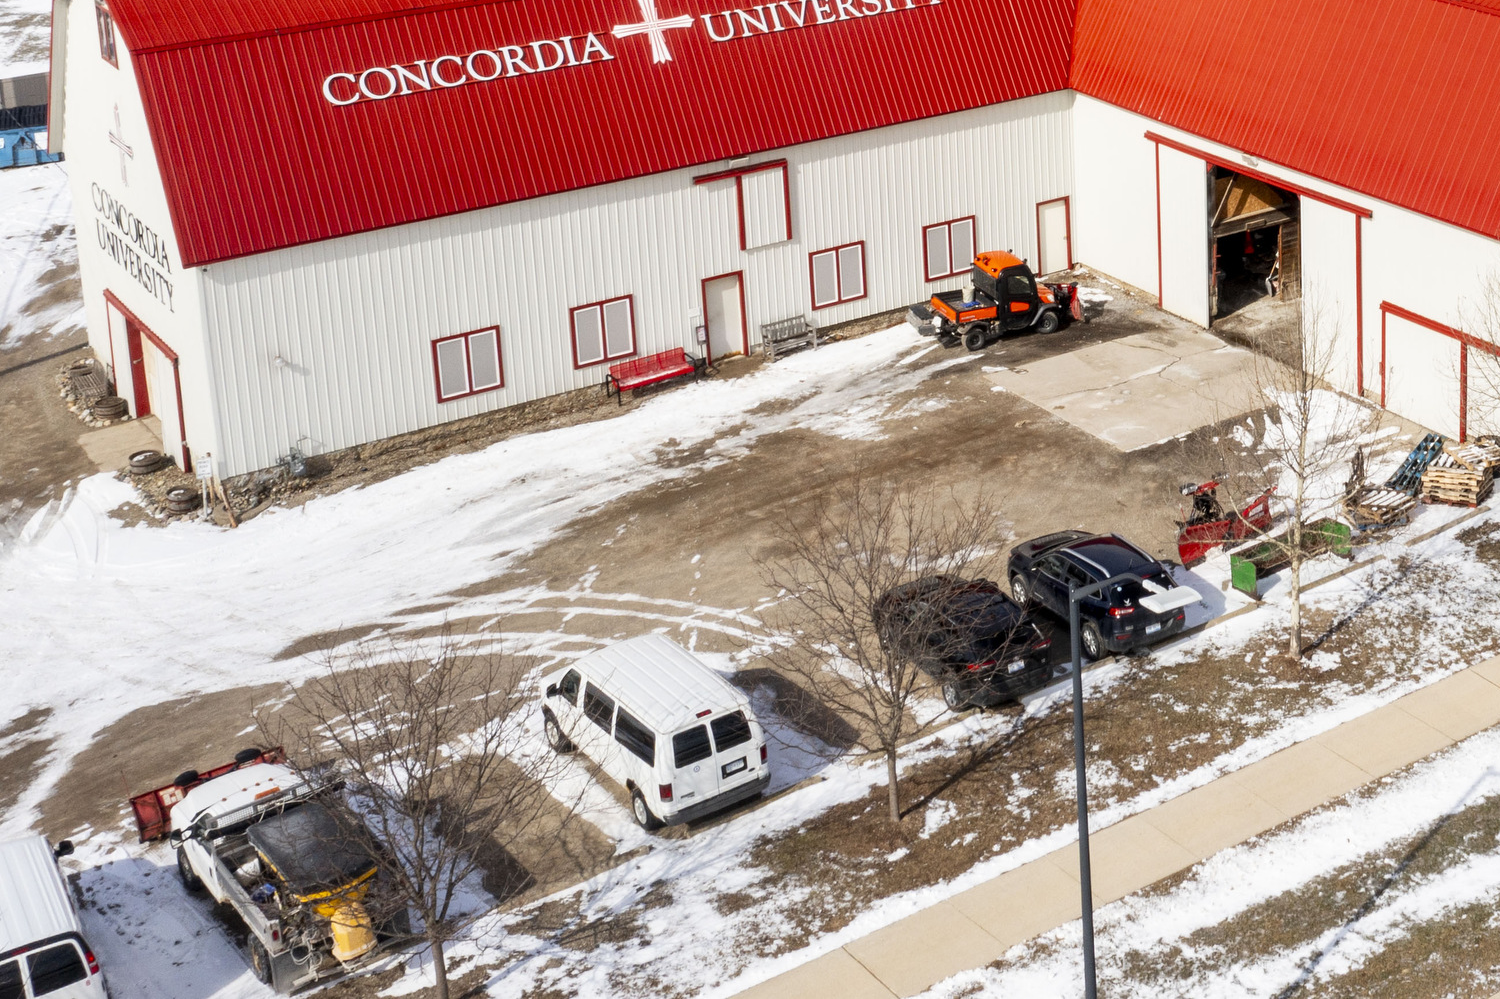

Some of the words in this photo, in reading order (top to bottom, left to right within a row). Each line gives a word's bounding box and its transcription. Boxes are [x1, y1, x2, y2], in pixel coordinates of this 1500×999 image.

[322, 31, 614, 106] CONCORDIA
[92, 182, 172, 275] CONCORDIA
[95, 217, 175, 313] UNIVERSITY
